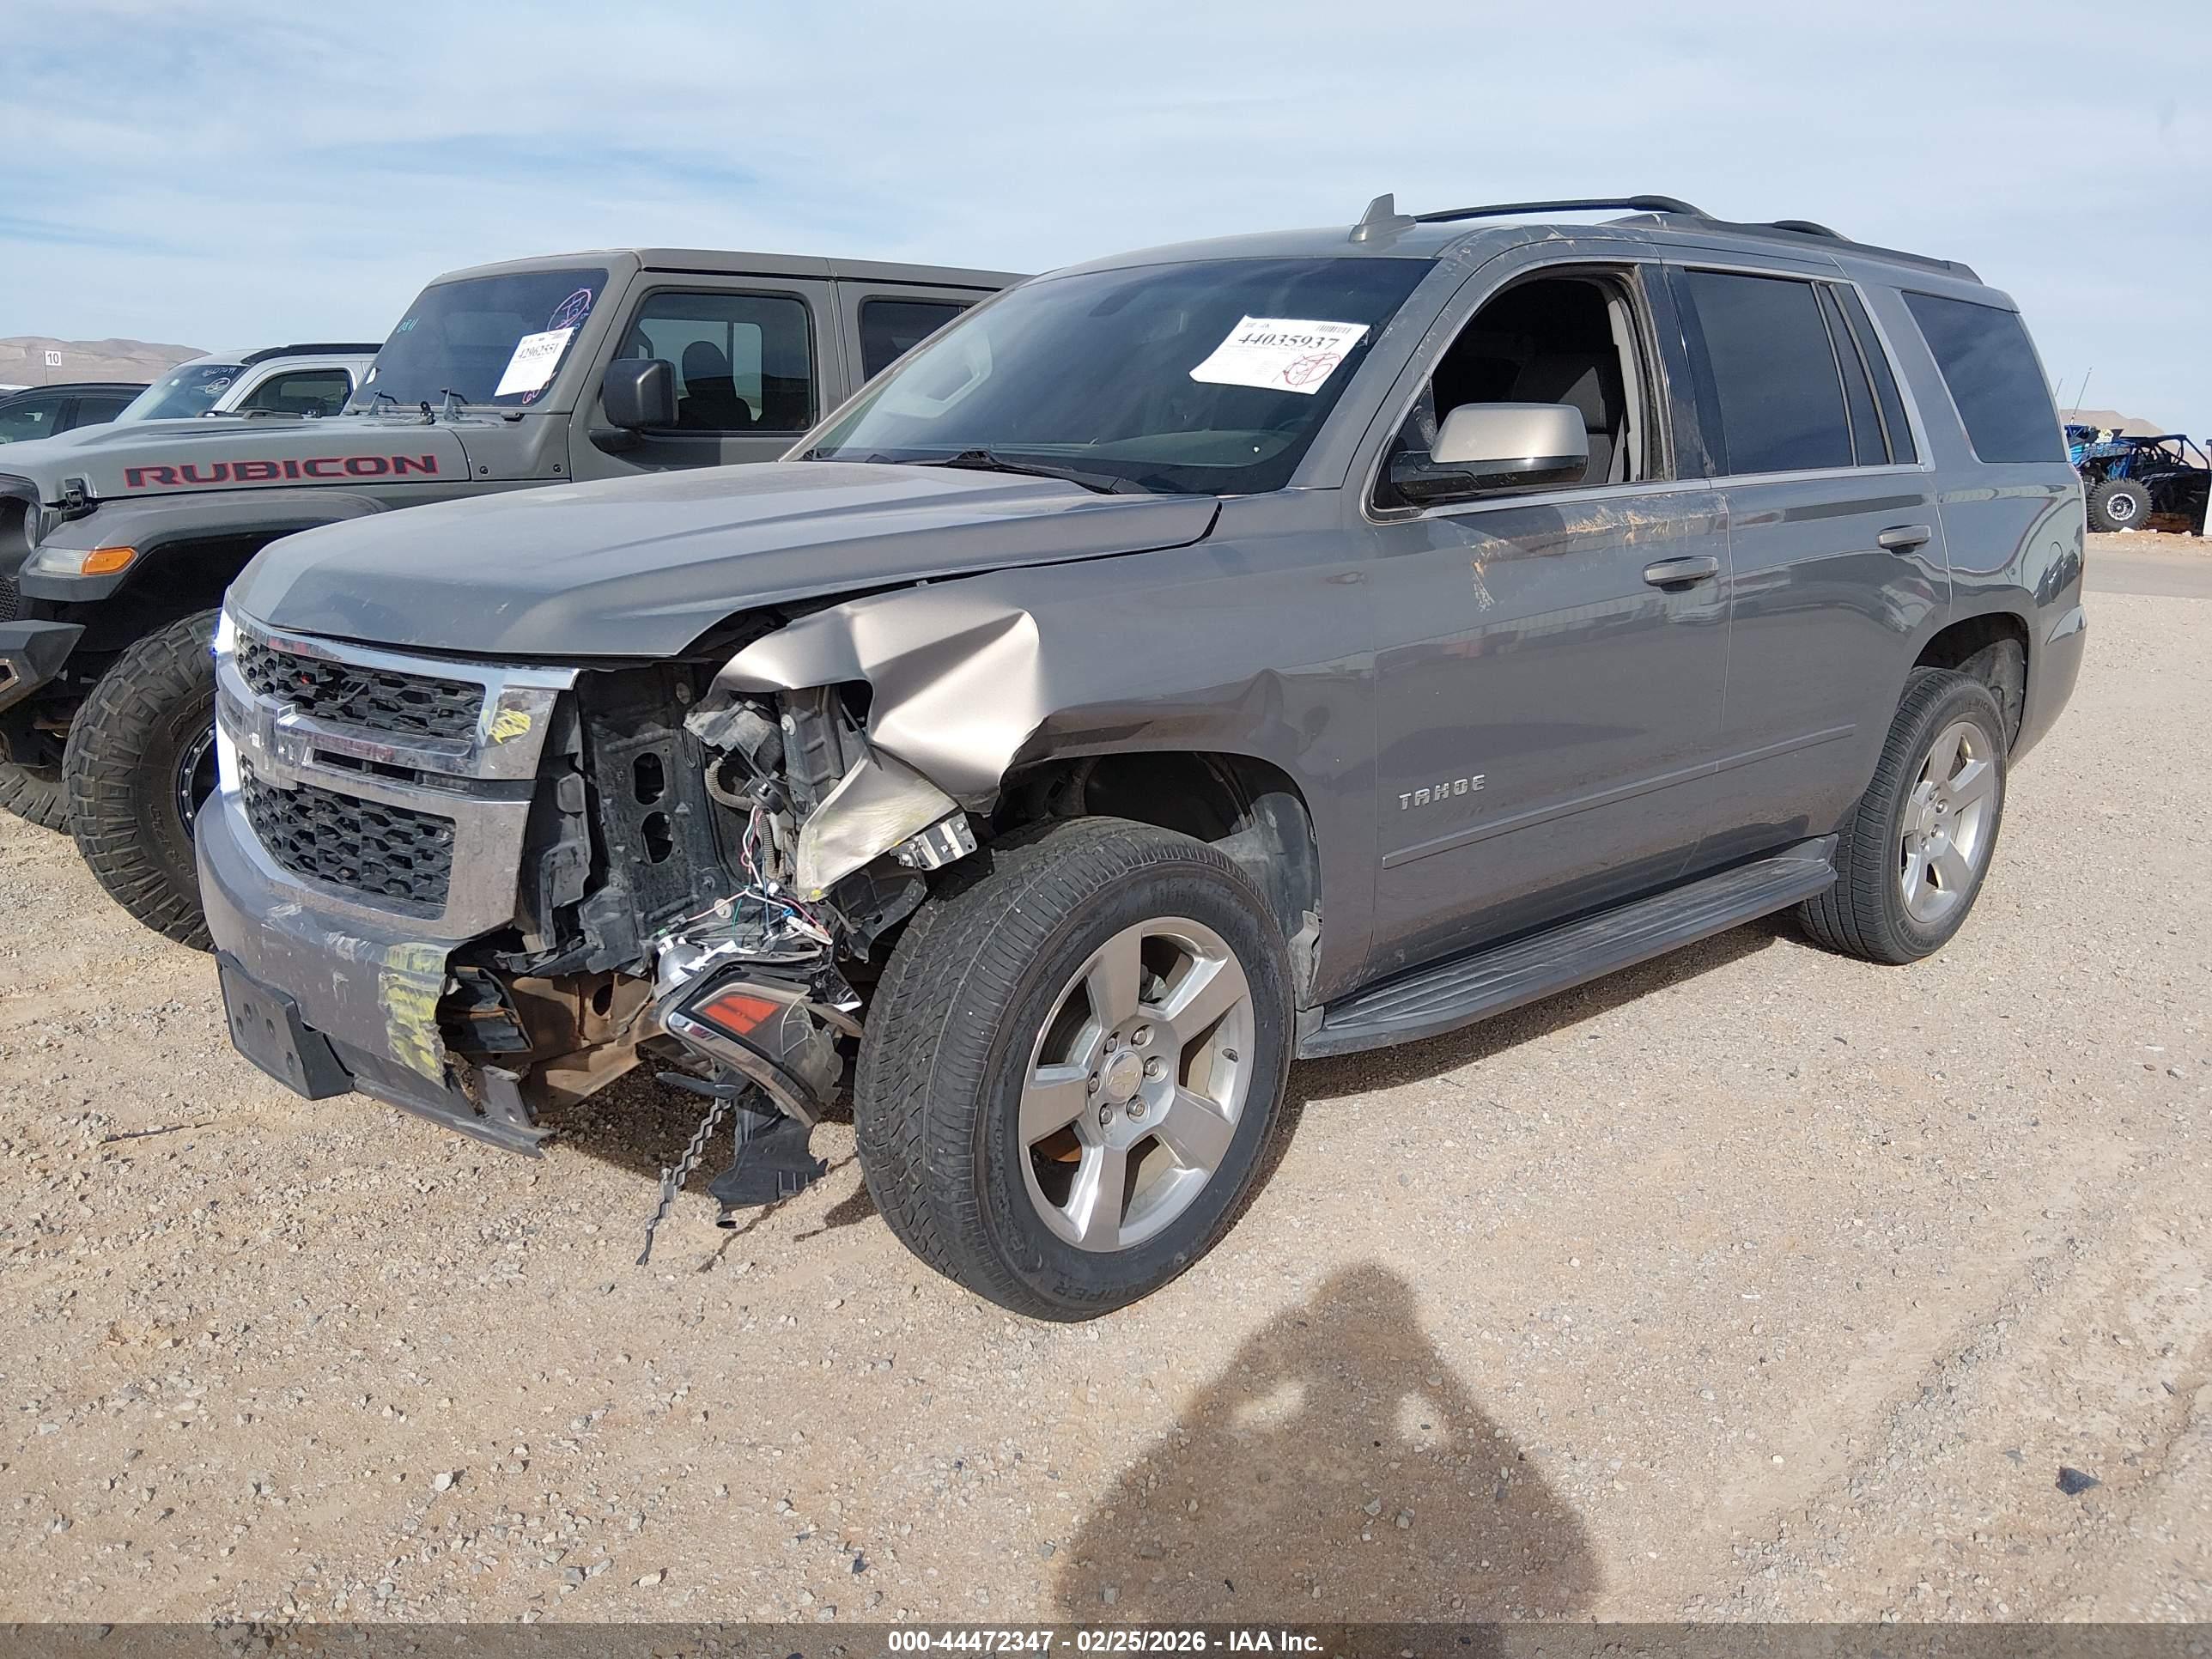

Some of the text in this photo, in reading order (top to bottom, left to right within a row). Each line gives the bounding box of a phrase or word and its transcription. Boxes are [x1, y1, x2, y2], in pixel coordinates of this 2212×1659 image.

[1238, 333, 1340, 350] 44035937
[47, 353, 59, 364] 10
[124, 454, 440, 489] RUBICON
[1399, 774, 1485, 810] TAHOE
